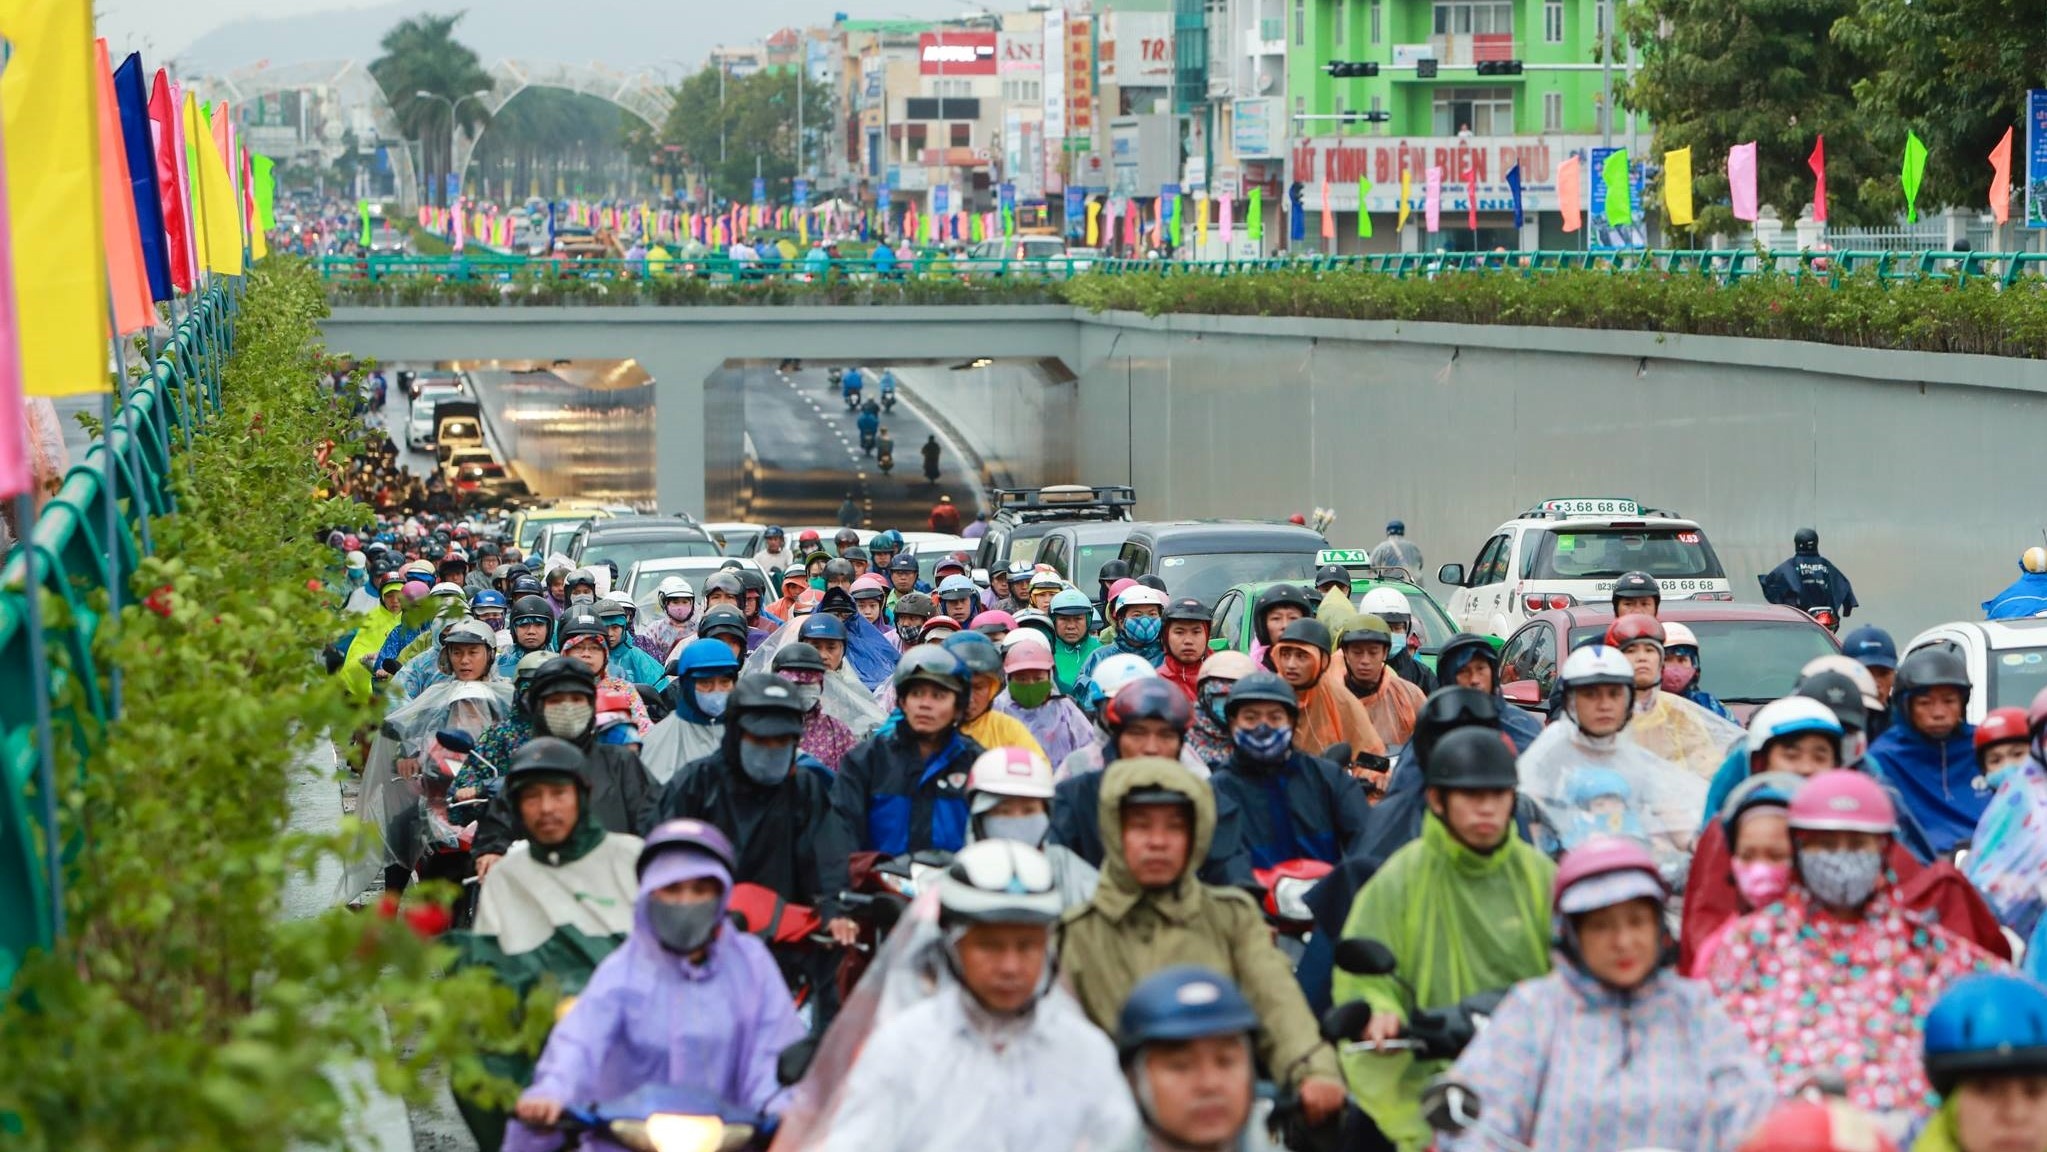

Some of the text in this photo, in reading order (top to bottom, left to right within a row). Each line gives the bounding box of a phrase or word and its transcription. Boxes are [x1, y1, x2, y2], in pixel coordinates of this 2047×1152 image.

[1597, 502, 1614, 512] 68
[1619, 502, 1635, 512] 68
[1323, 551, 1365, 562] TAXI
[1680, 581, 1695, 590] 68
[1699, 581, 1714, 590] 68
